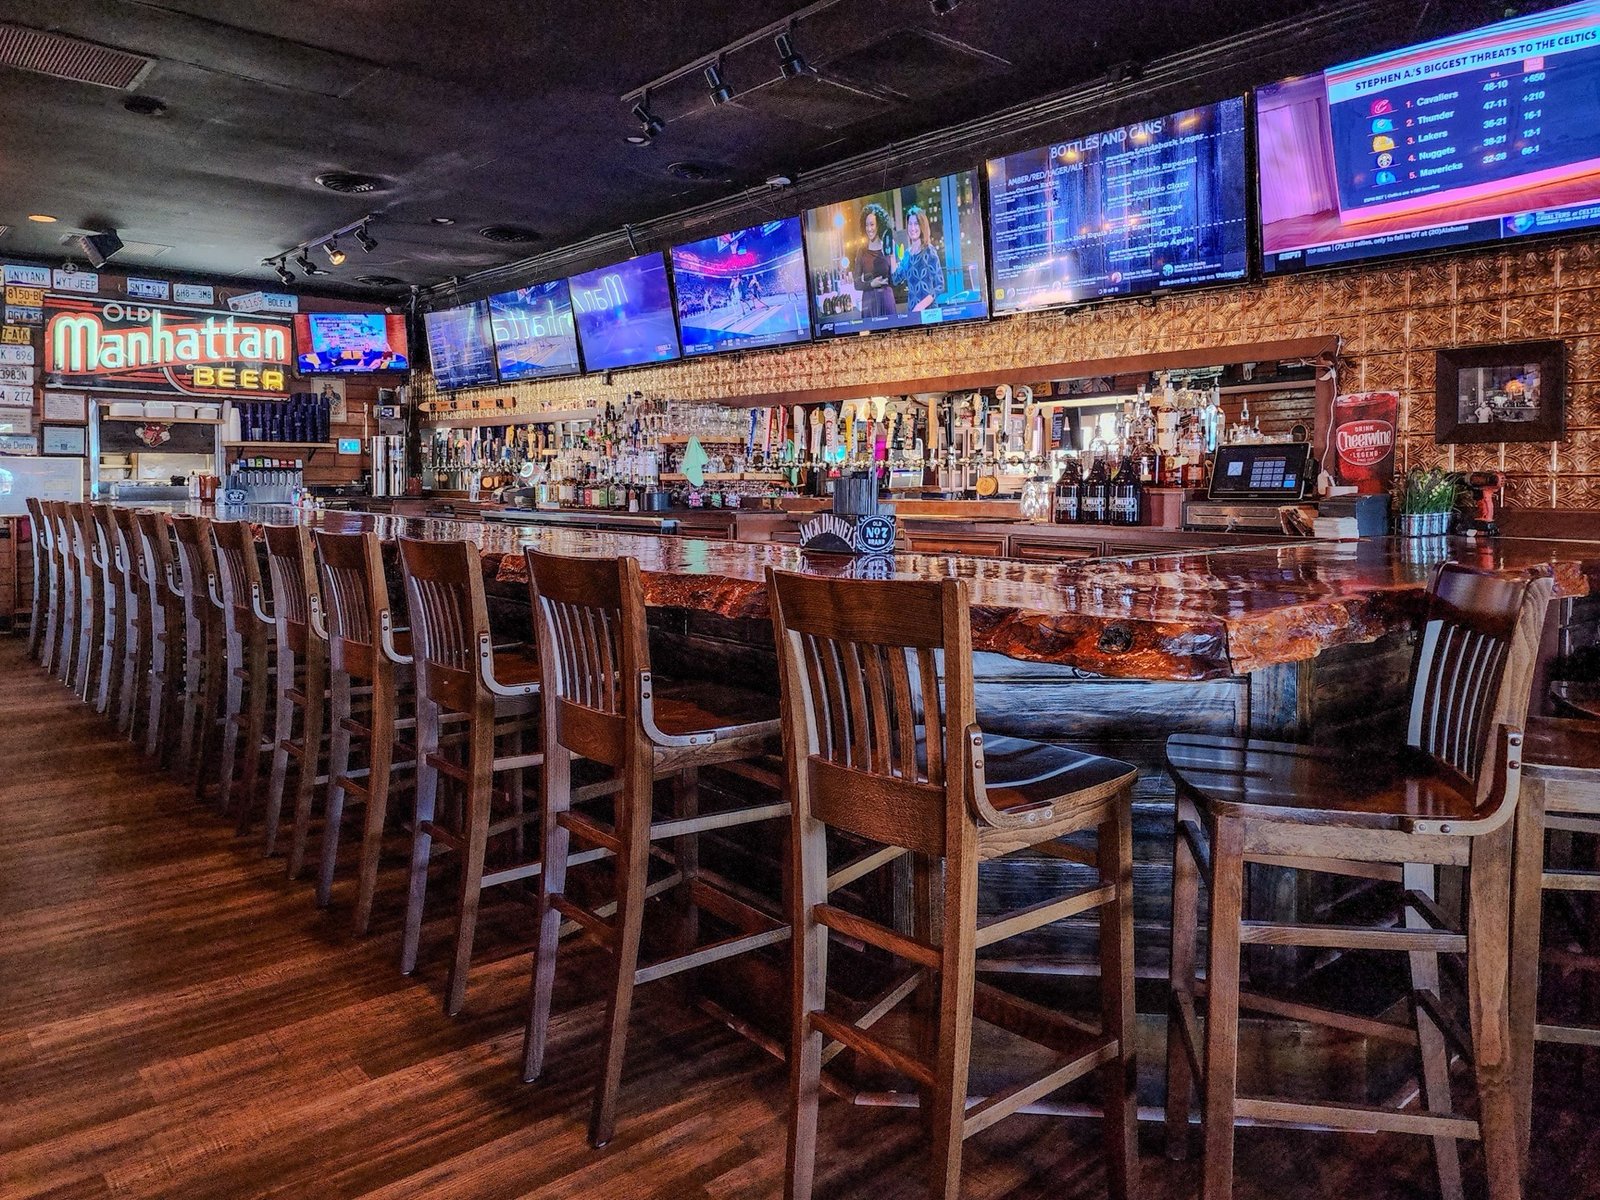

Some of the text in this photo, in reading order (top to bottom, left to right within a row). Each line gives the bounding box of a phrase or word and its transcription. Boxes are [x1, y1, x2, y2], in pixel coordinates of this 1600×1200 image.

[1355, 72, 1401, 91] STEPHEN
[1423, 55, 1467, 74] BIGGEST
[1469, 46, 1517, 63] THREATS
[1519, 43, 1533, 53] TO
[1535, 38, 1555, 51] THE
[1557, 30, 1597, 46] CELTICS
[1416, 91, 1459, 106] Cavaliers
[1483, 79, 1508, 92] 48-10
[1417, 110, 1455, 124] Thunder
[1482, 98, 1507, 110] 47-11
[1522, 91, 1545, 102] +210
[1050, 137, 1099, 160] BOTTLES
[1101, 129, 1127, 147] AND
[1129, 121, 1162, 139] CANS
[1180, 133, 1205, 144] Lager
[1418, 130, 1448, 142] Lakers
[1418, 146, 1456, 160] Nuggets
[1523, 127, 1541, 138] 12-1
[1132, 165, 1160, 176] Modelo
[1162, 156, 1197, 169] Especial
[1420, 162, 1464, 177] Mavericks
[1160, 226, 1182, 236] CIDER
[1373, 236, 1386, 244] only
[1411, 231, 1420, 239] OT
[1148, 236, 1194, 250] Crisp Apple
[74, 279, 97, 290] JEEP
[130, 282, 166, 295] SNT 812
[102, 303, 151, 322] OLD
[53, 309, 285, 372] Manhattan
[15, 350, 32, 361] 896
[192, 366, 284, 391] BEER
[1337, 430, 1391, 452] Cheerwine
[1352, 450, 1378, 458] LEGEND
[800, 513, 858, 552] JACK DANIEL'S
